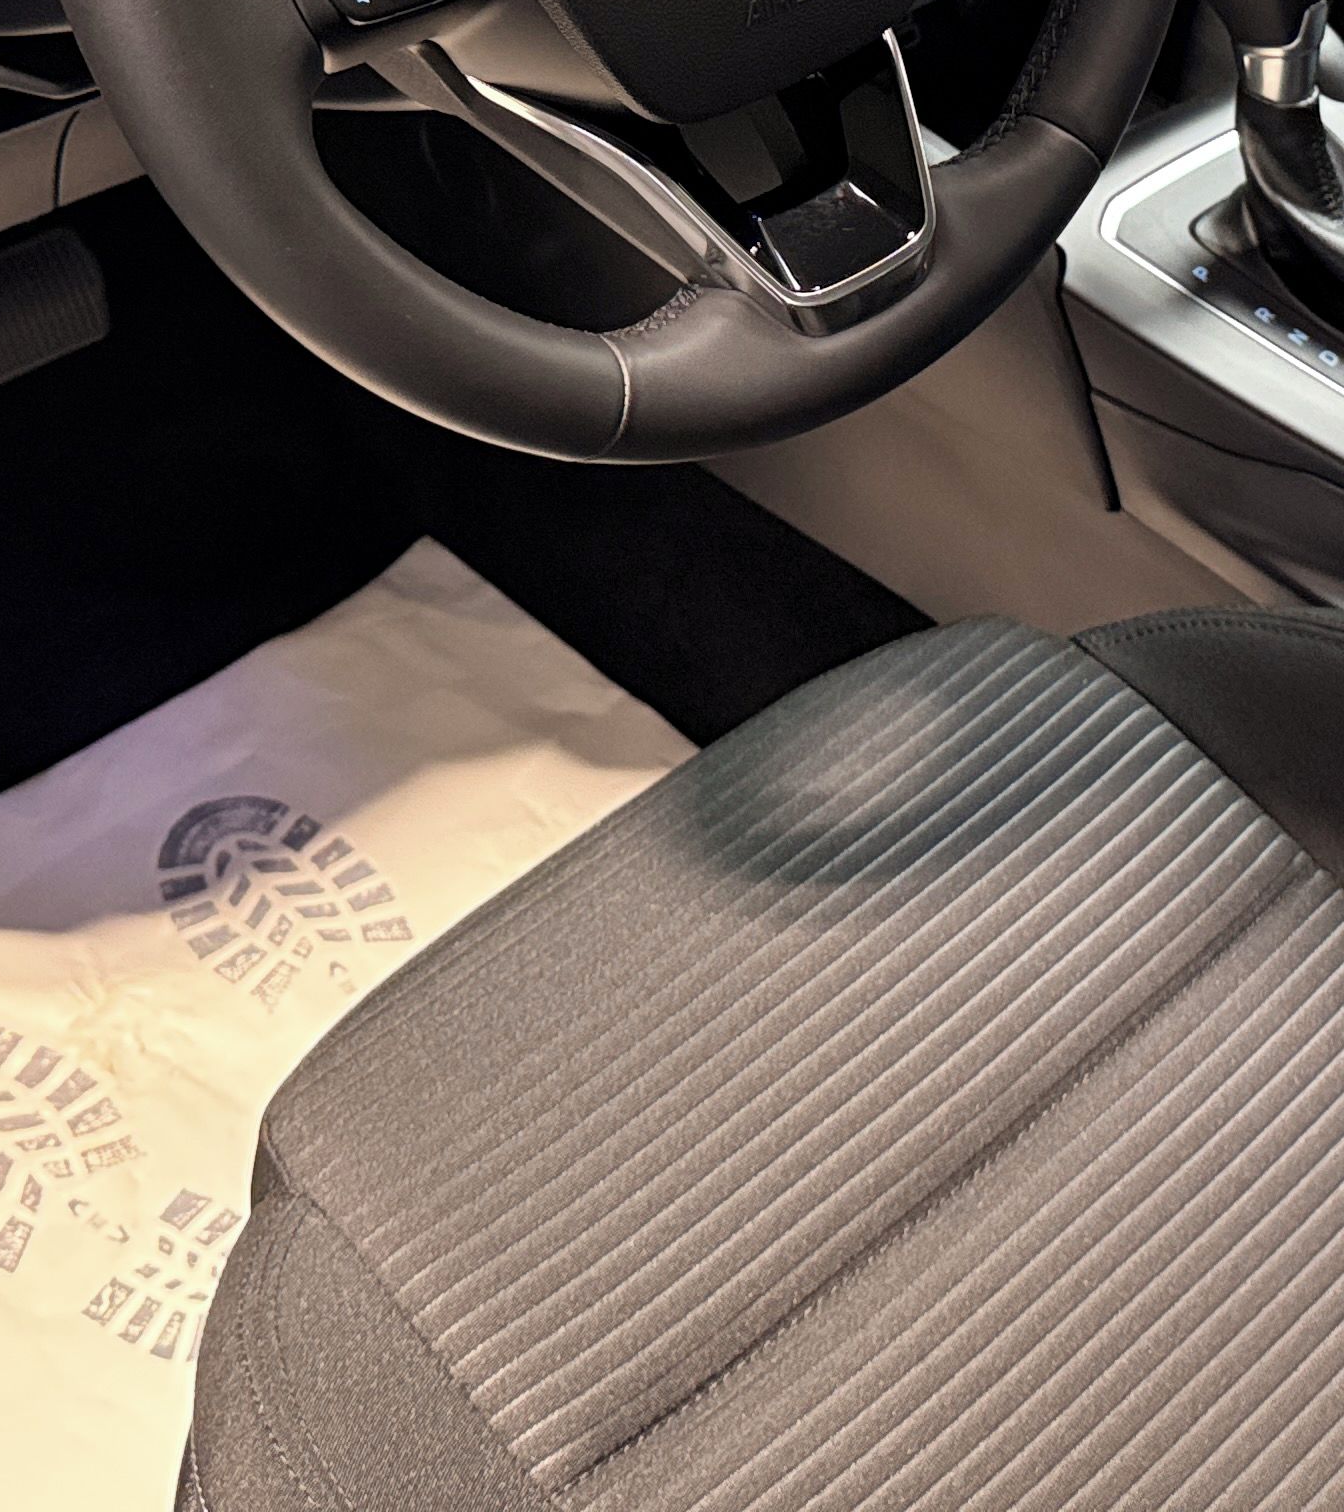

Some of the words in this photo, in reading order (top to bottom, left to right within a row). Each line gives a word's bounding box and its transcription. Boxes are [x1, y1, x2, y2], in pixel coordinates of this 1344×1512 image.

[1191, 265, 1209, 283] P
[1254, 306, 1277, 324] R
[1287, 327, 1311, 347] N
[1318, 349, 1340, 368] D
